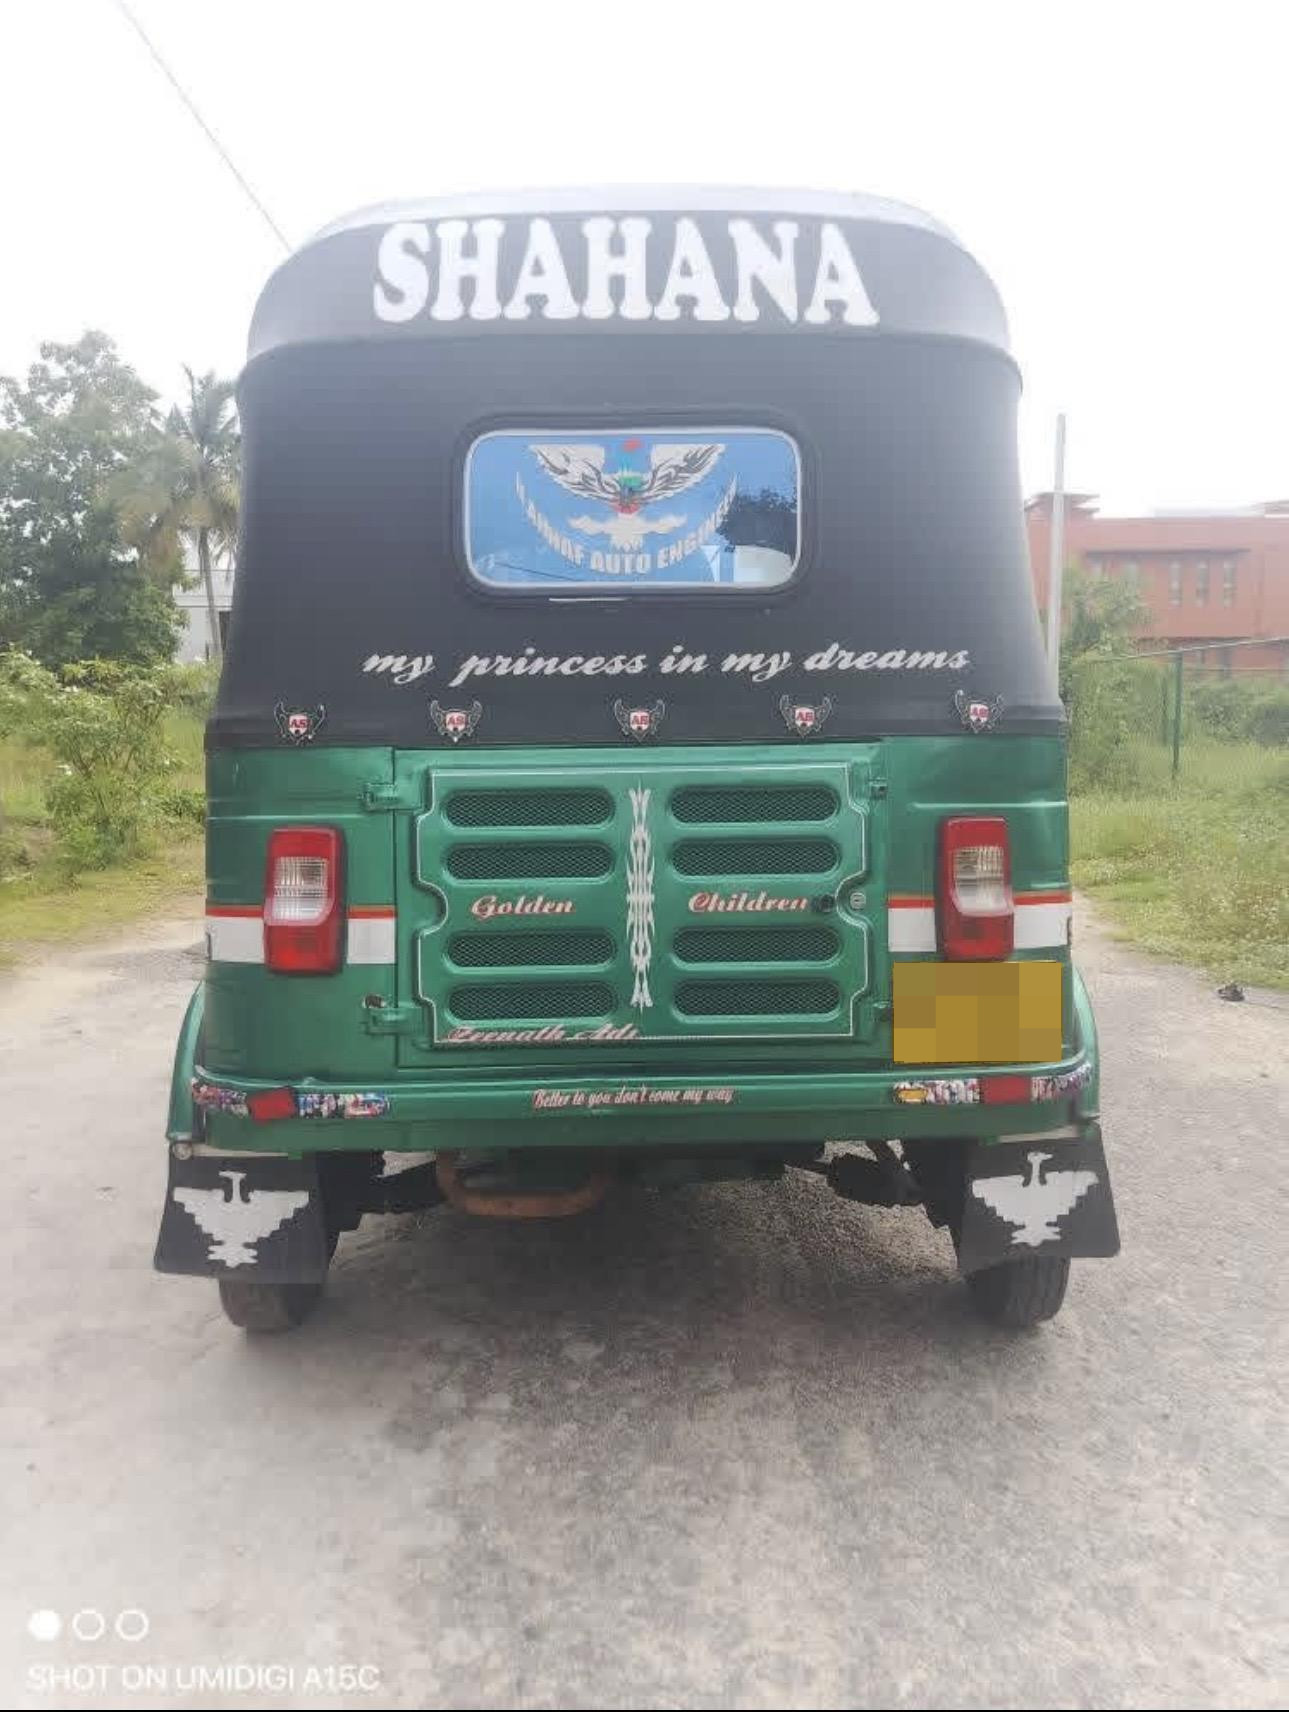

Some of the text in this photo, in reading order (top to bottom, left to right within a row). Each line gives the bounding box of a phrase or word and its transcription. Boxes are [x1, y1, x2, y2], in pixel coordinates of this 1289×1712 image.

[373, 217, 880, 326] SHAHANA
[590, 551, 651, 575] AUTO
[361, 642, 970, 688] my princess in my dreams
[471, 890, 808, 920] Golden Children
